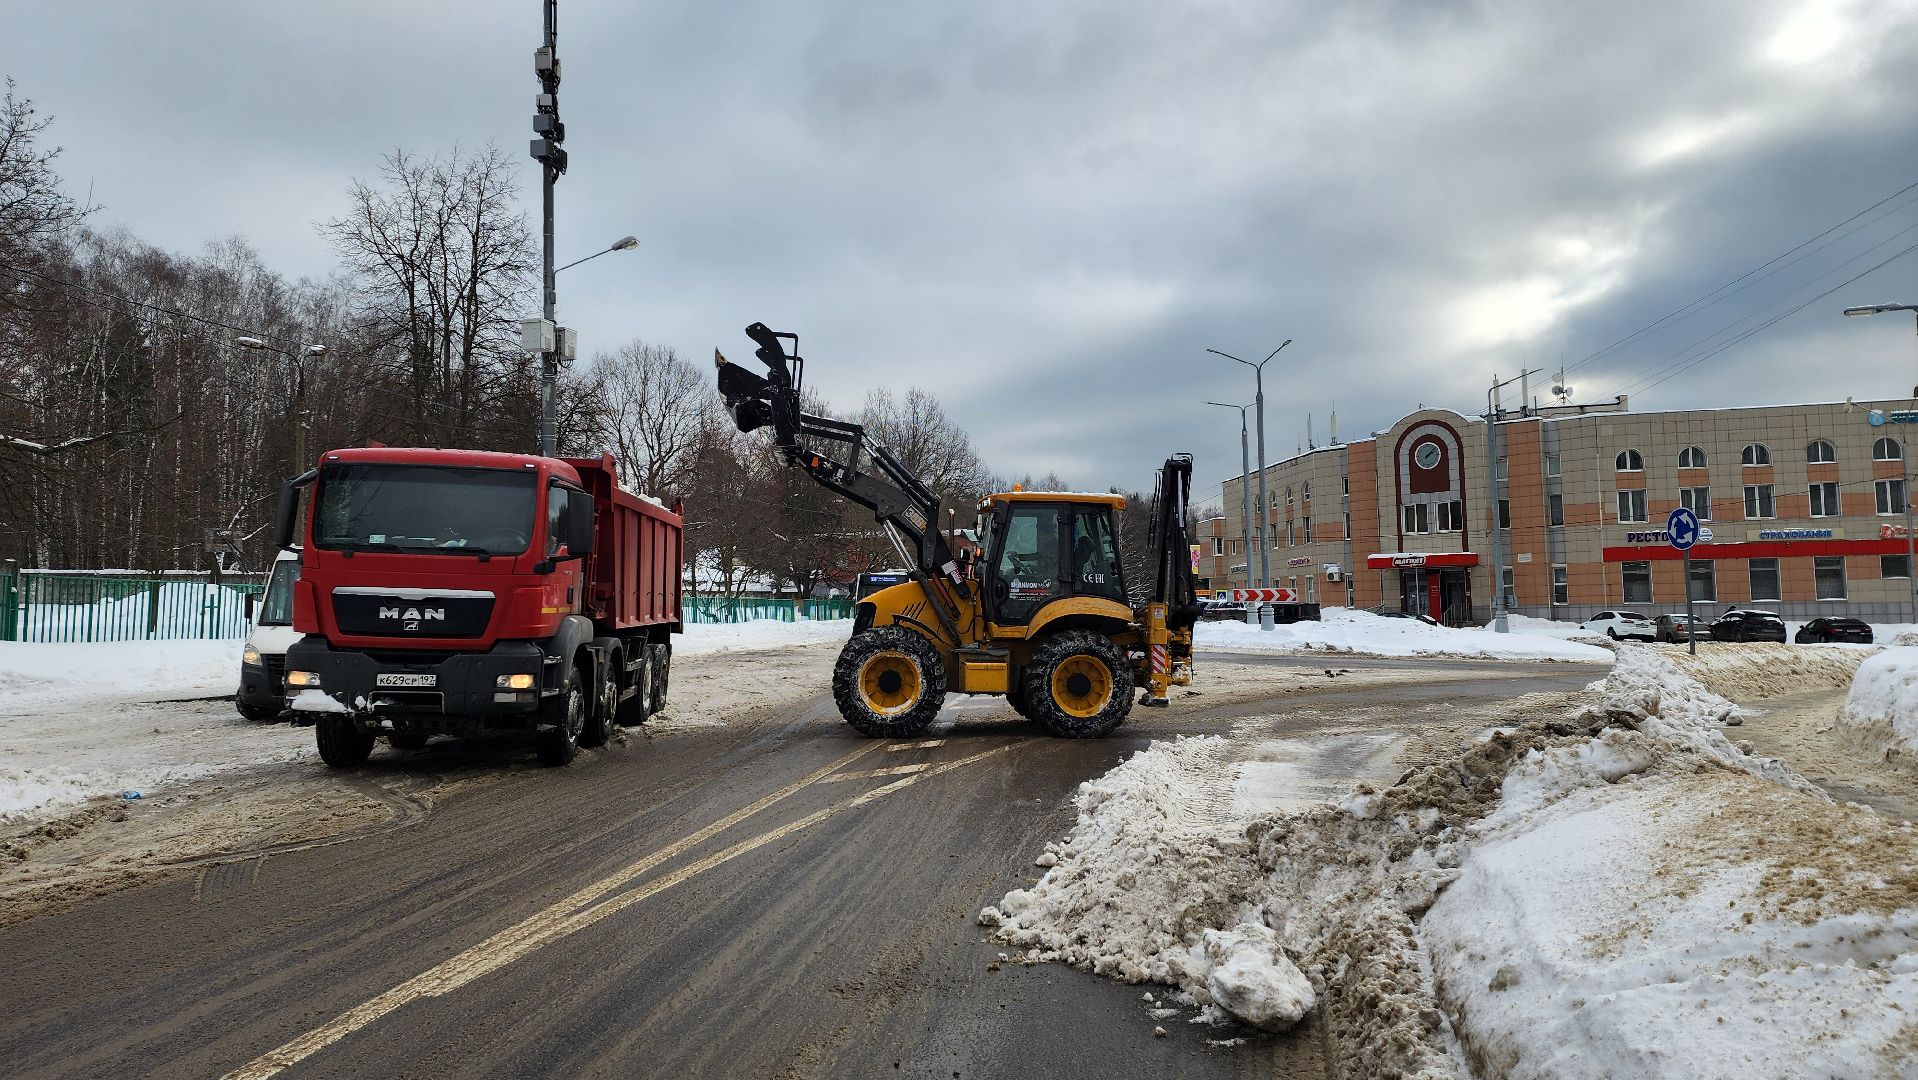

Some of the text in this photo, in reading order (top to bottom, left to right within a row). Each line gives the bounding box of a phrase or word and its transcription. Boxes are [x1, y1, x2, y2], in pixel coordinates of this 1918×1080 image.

[1627, 531, 1668, 542] РЕСТО
[1759, 529, 1832, 540] СТРАХОВАНИЕ
[379, 607, 445, 620] MAN
